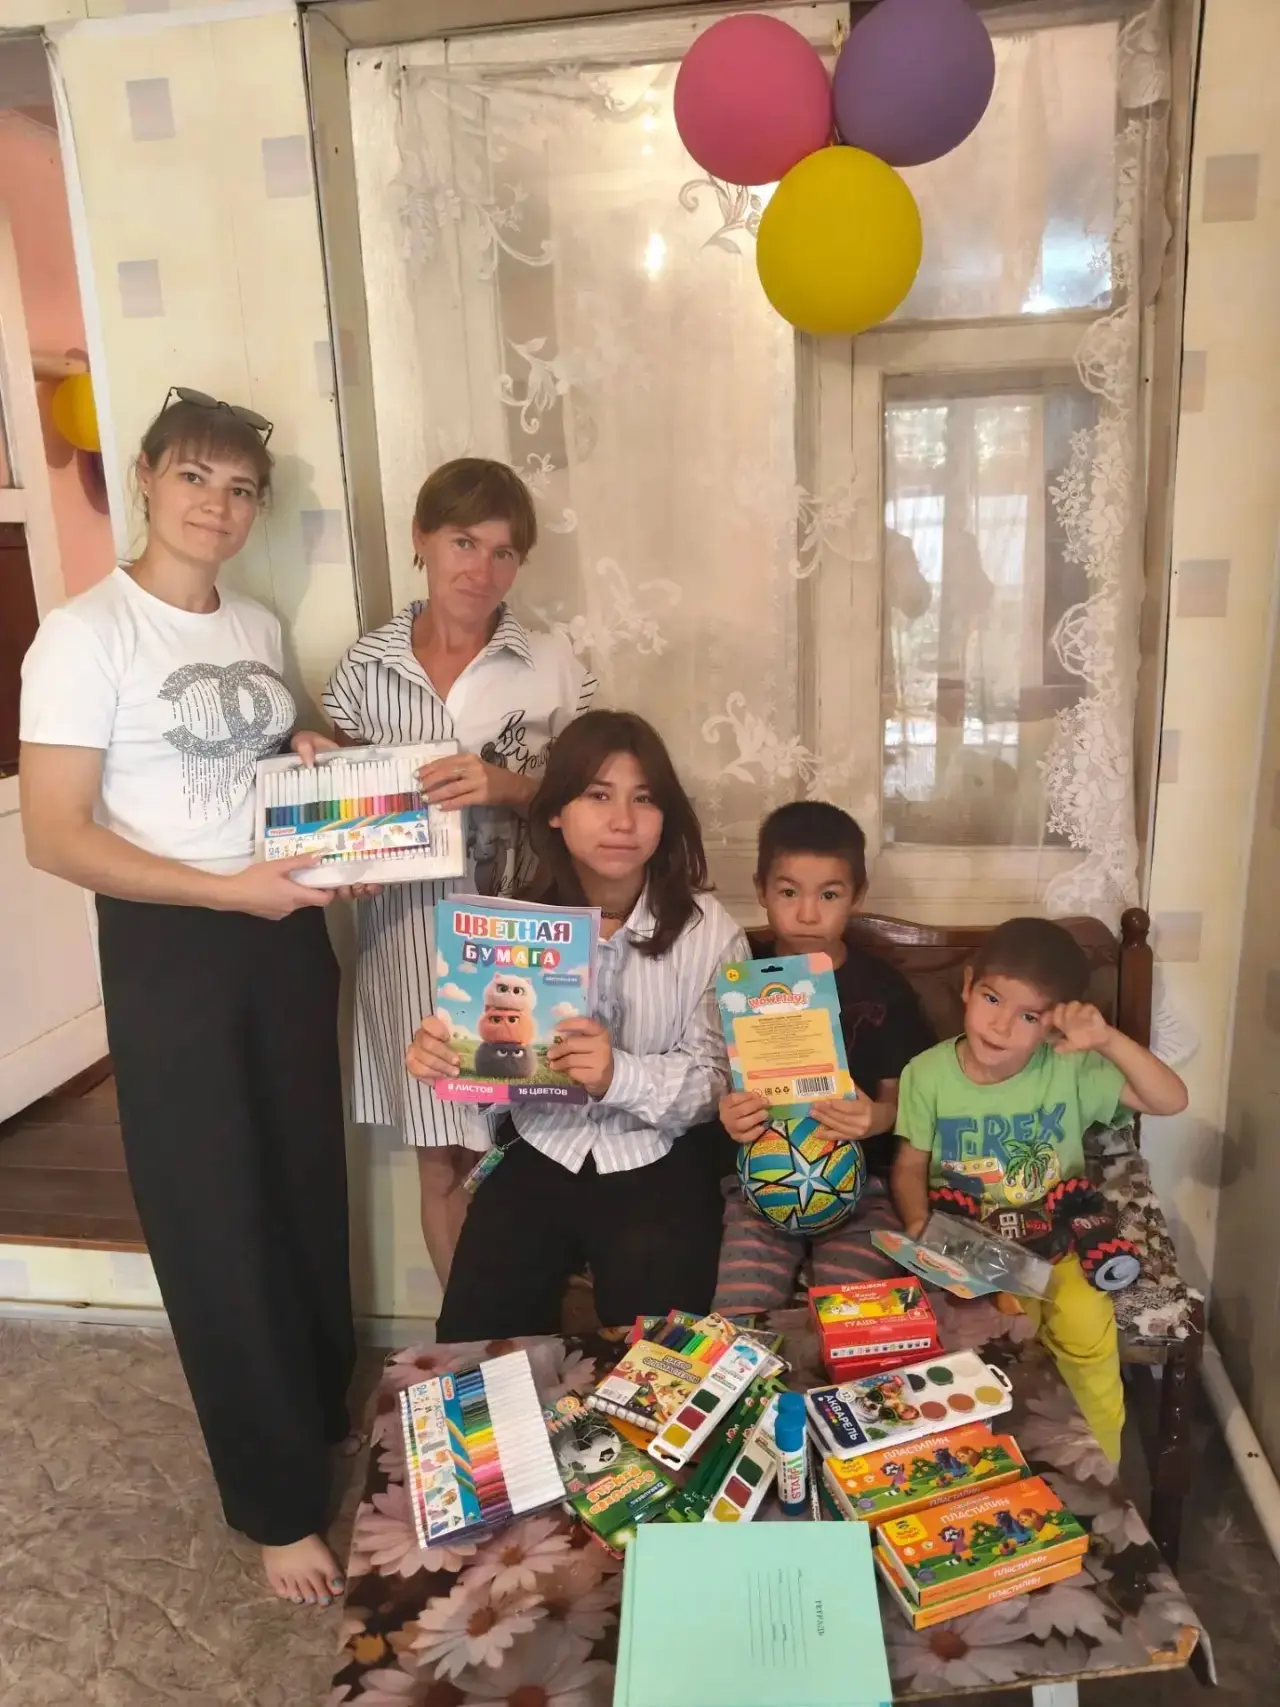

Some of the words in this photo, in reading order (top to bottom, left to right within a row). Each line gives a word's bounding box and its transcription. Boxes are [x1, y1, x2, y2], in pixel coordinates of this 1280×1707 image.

[454, 912, 572, 943] ЦВЕТНАЯ
[463, 944, 560, 967] БУМАГА
[456, 1084, 493, 1094] ЛИСТОВ
[529, 1087, 568, 1096] ЦВЕТОВ
[824, 1394, 859, 1441] АКВАРЕЛЬ
[883, 1436, 950, 1459] ПЛАСТИЛИН
[929, 1487, 981, 1506] ПЛАСТИЛИН
[940, 1498, 1010, 1524] ПЛАСТИЛИН
[993, 1555, 1048, 1577] ПЛАСТИЛИН
[988, 1576, 1041, 1600] ПЛАСТИЛИН
[815, 1600, 825, 1636] ТЕТРАДЬ
